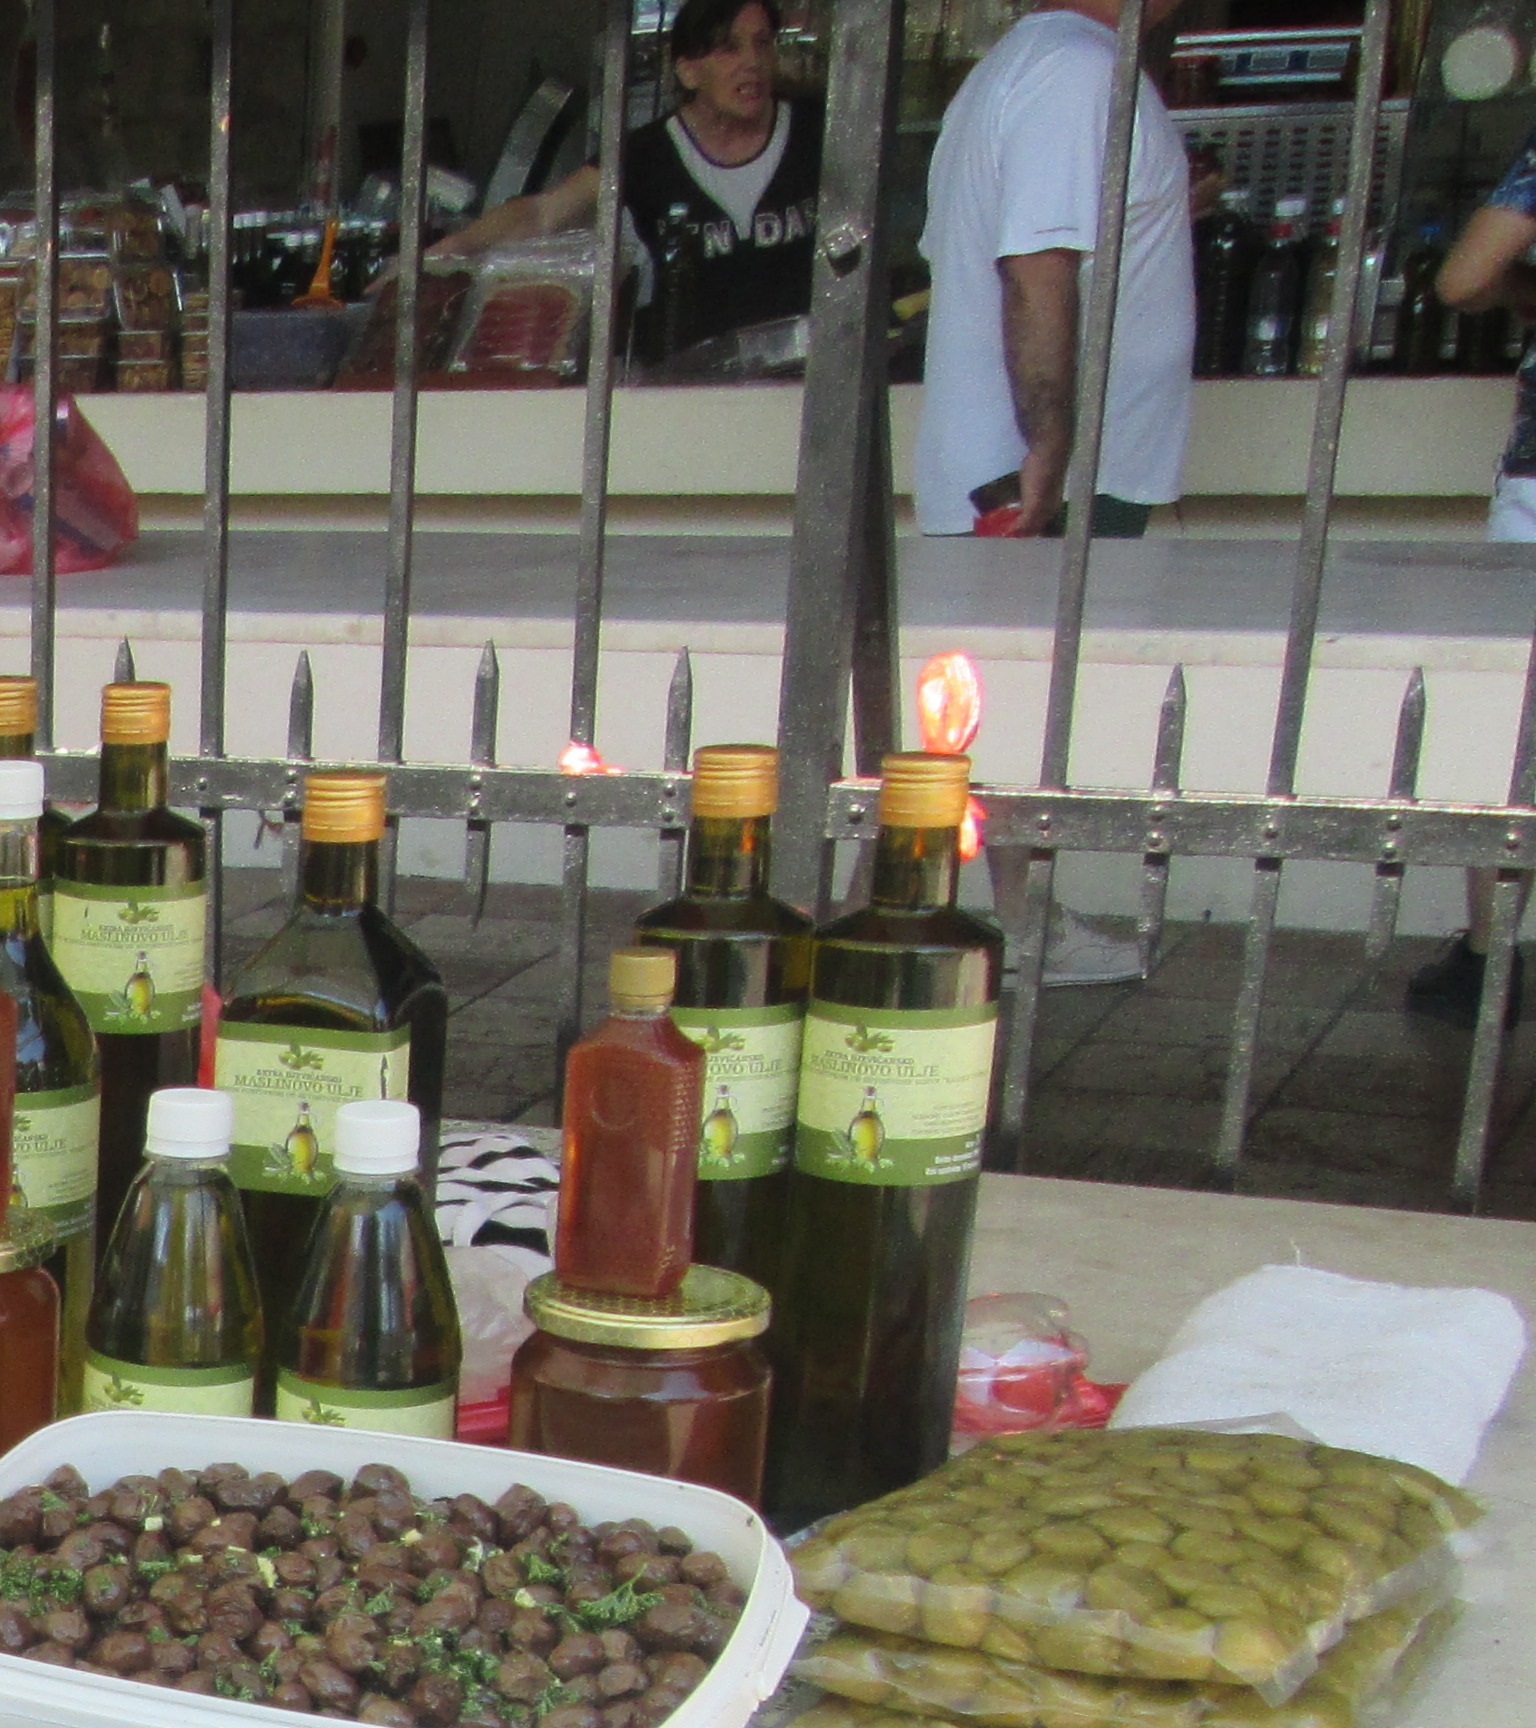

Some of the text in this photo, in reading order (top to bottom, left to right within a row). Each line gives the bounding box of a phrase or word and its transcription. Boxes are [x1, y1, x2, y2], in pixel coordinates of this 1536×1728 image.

[896, 1064, 939, 1078] ULJE
[234, 1074, 364, 1098] MASLINOVO ULJE
